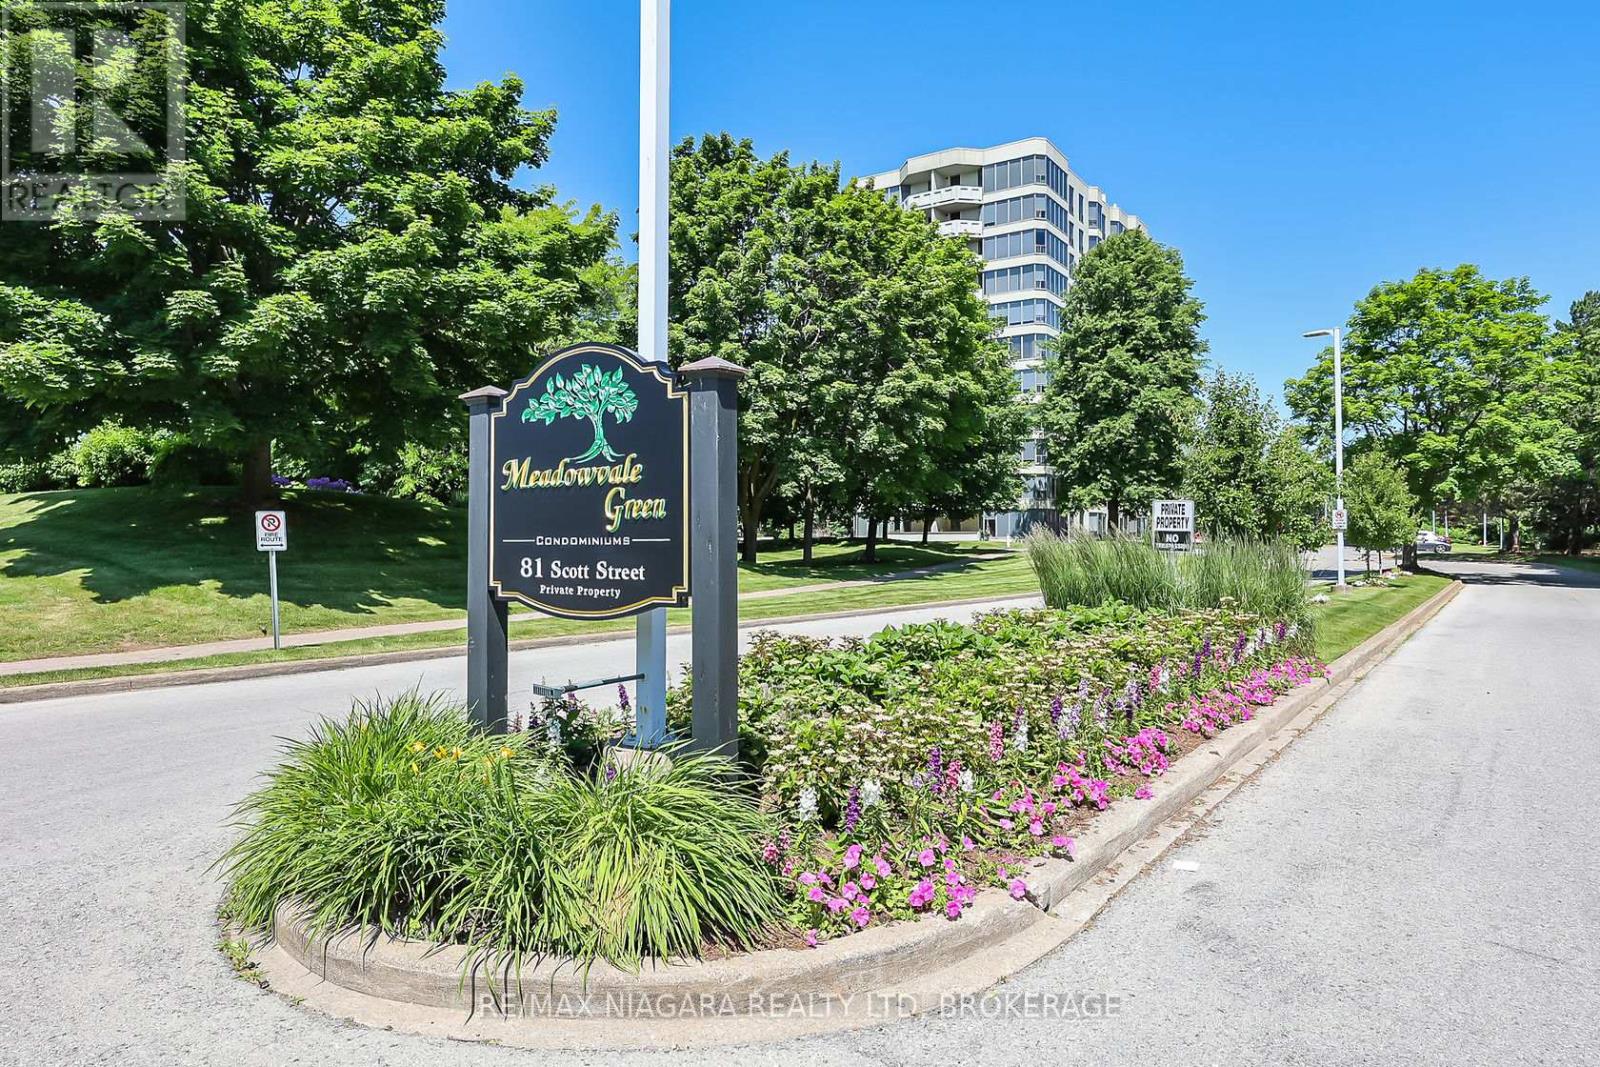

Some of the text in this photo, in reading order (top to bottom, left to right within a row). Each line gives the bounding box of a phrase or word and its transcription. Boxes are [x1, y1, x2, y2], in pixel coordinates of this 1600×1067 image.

[501, 453, 643, 491] Meadowvale
[604, 486, 667, 533] Green
[1160, 503, 1186, 515] PRIVATE
[1156, 516, 1190, 529] PROPERTY
[1165, 534, 1179, 543] NO
[520, 557, 646, 581] 81 Scott Street
[539, 584, 621, 599] Private Property
